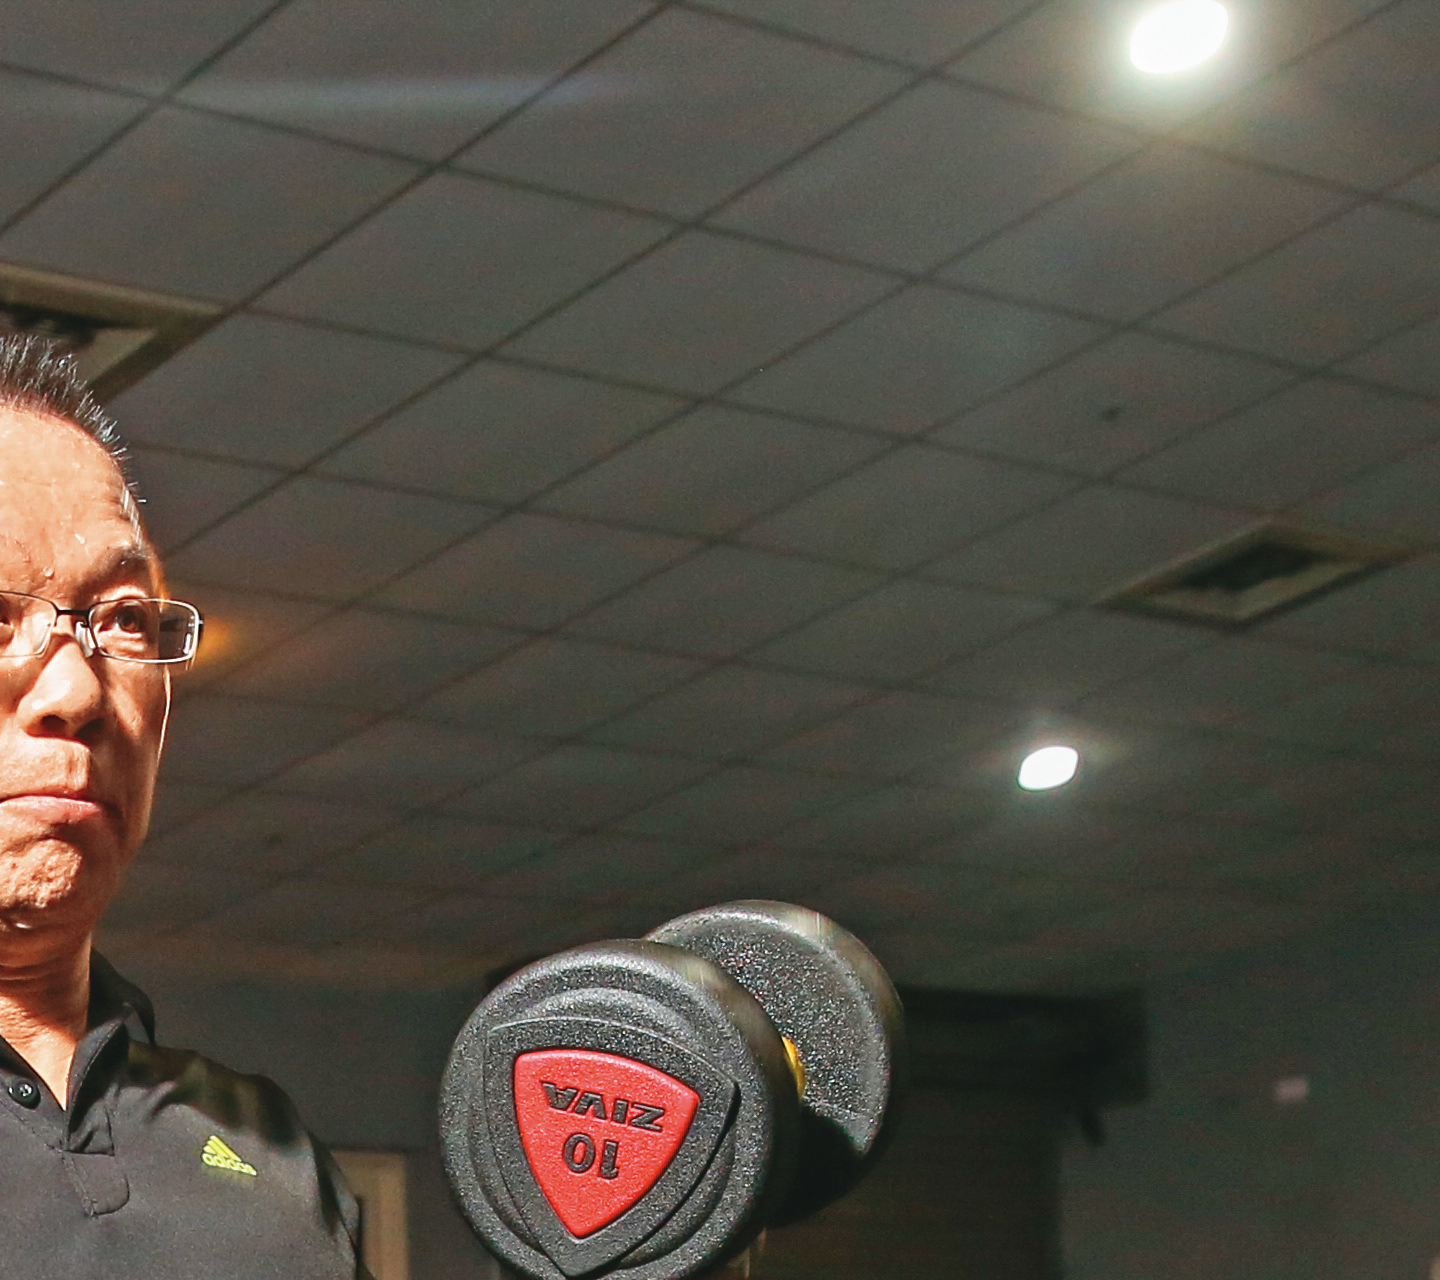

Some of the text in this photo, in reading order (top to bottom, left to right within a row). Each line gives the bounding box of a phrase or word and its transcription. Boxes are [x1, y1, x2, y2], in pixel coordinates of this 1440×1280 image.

[539, 1080, 666, 1133] ZIVA
[201, 1152, 258, 1176] adidas
[562, 1131, 620, 1180] 10
